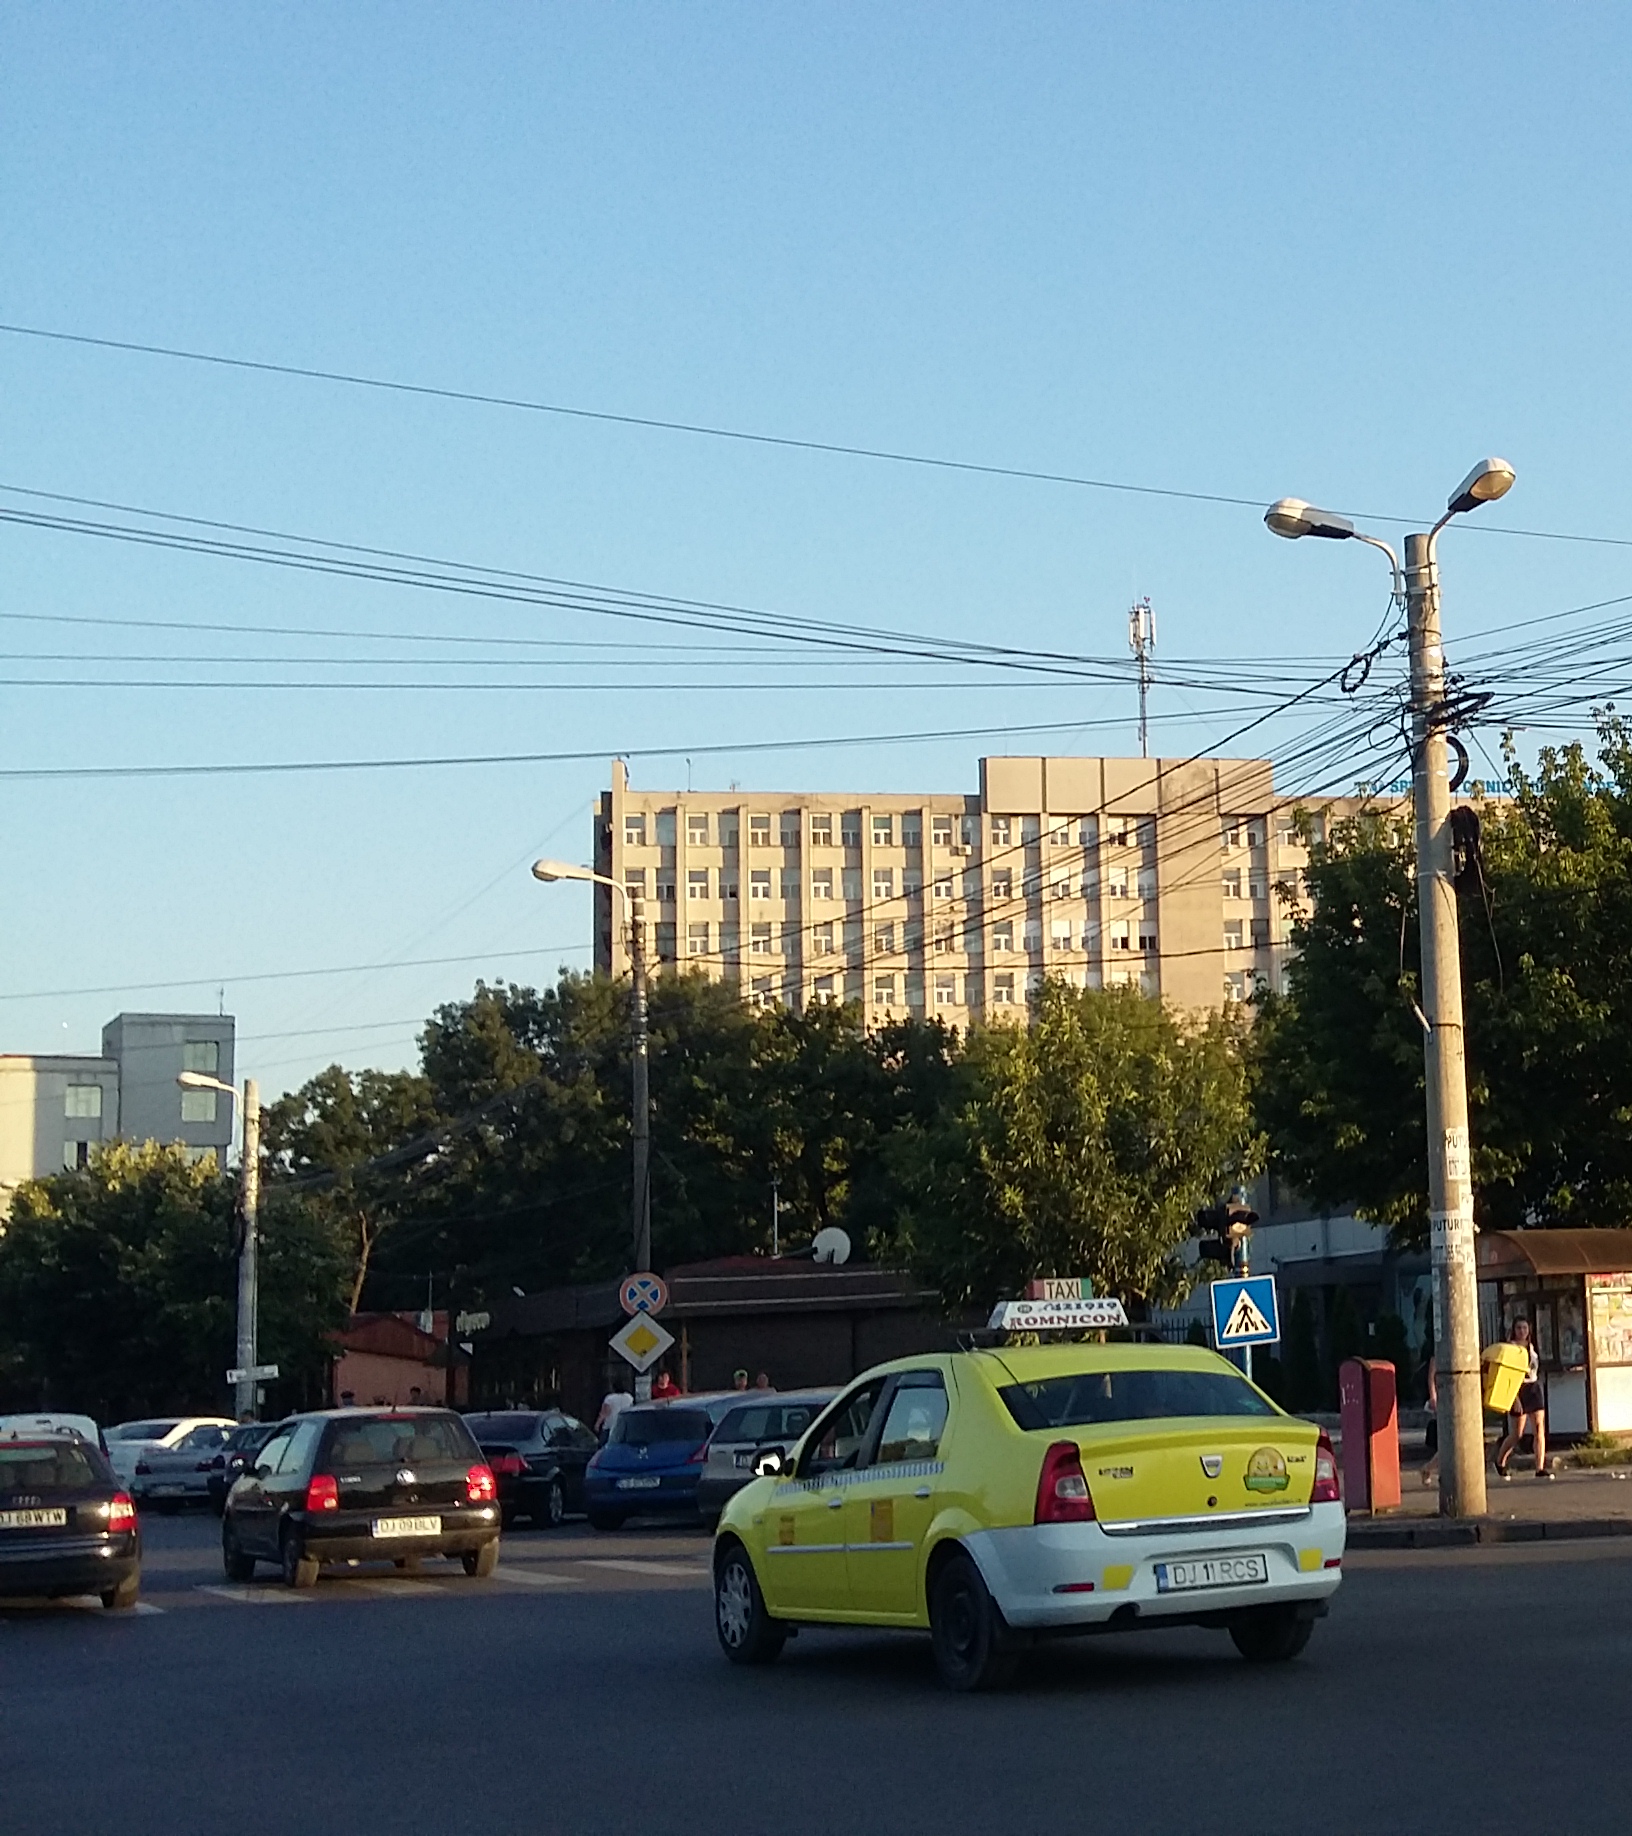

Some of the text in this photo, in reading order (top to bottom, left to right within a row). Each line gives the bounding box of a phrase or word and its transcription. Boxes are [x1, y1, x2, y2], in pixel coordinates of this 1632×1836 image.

[1046, 1281, 1080, 1300] TAXI
[1009, 1314, 1121, 1328] ROMNICON
[380, 1519, 395, 1533] DJ
[1172, 1559, 1259, 1585] DJ 11 RCS
